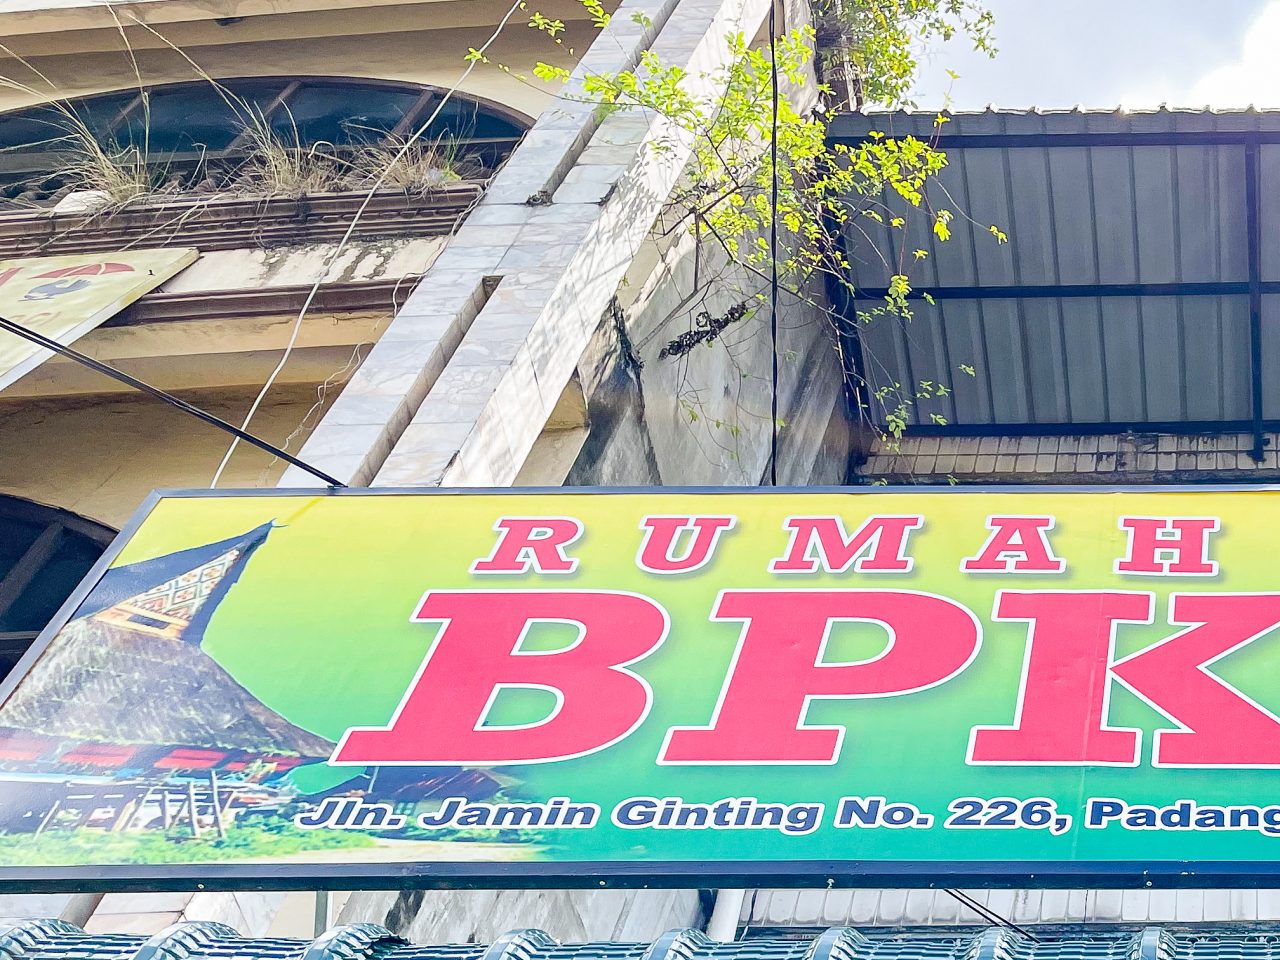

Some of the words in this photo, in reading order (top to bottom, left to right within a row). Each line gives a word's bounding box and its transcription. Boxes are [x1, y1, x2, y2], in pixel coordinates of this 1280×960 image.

[469, 514, 1221, 576] RUMAH
[297, 798, 404, 828] Jln.
[420, 798, 599, 828] Jamin
[615, 799, 822, 833] Ginting
[837, 799, 933, 828] No.
[946, 799, 1071, 832] 226,
